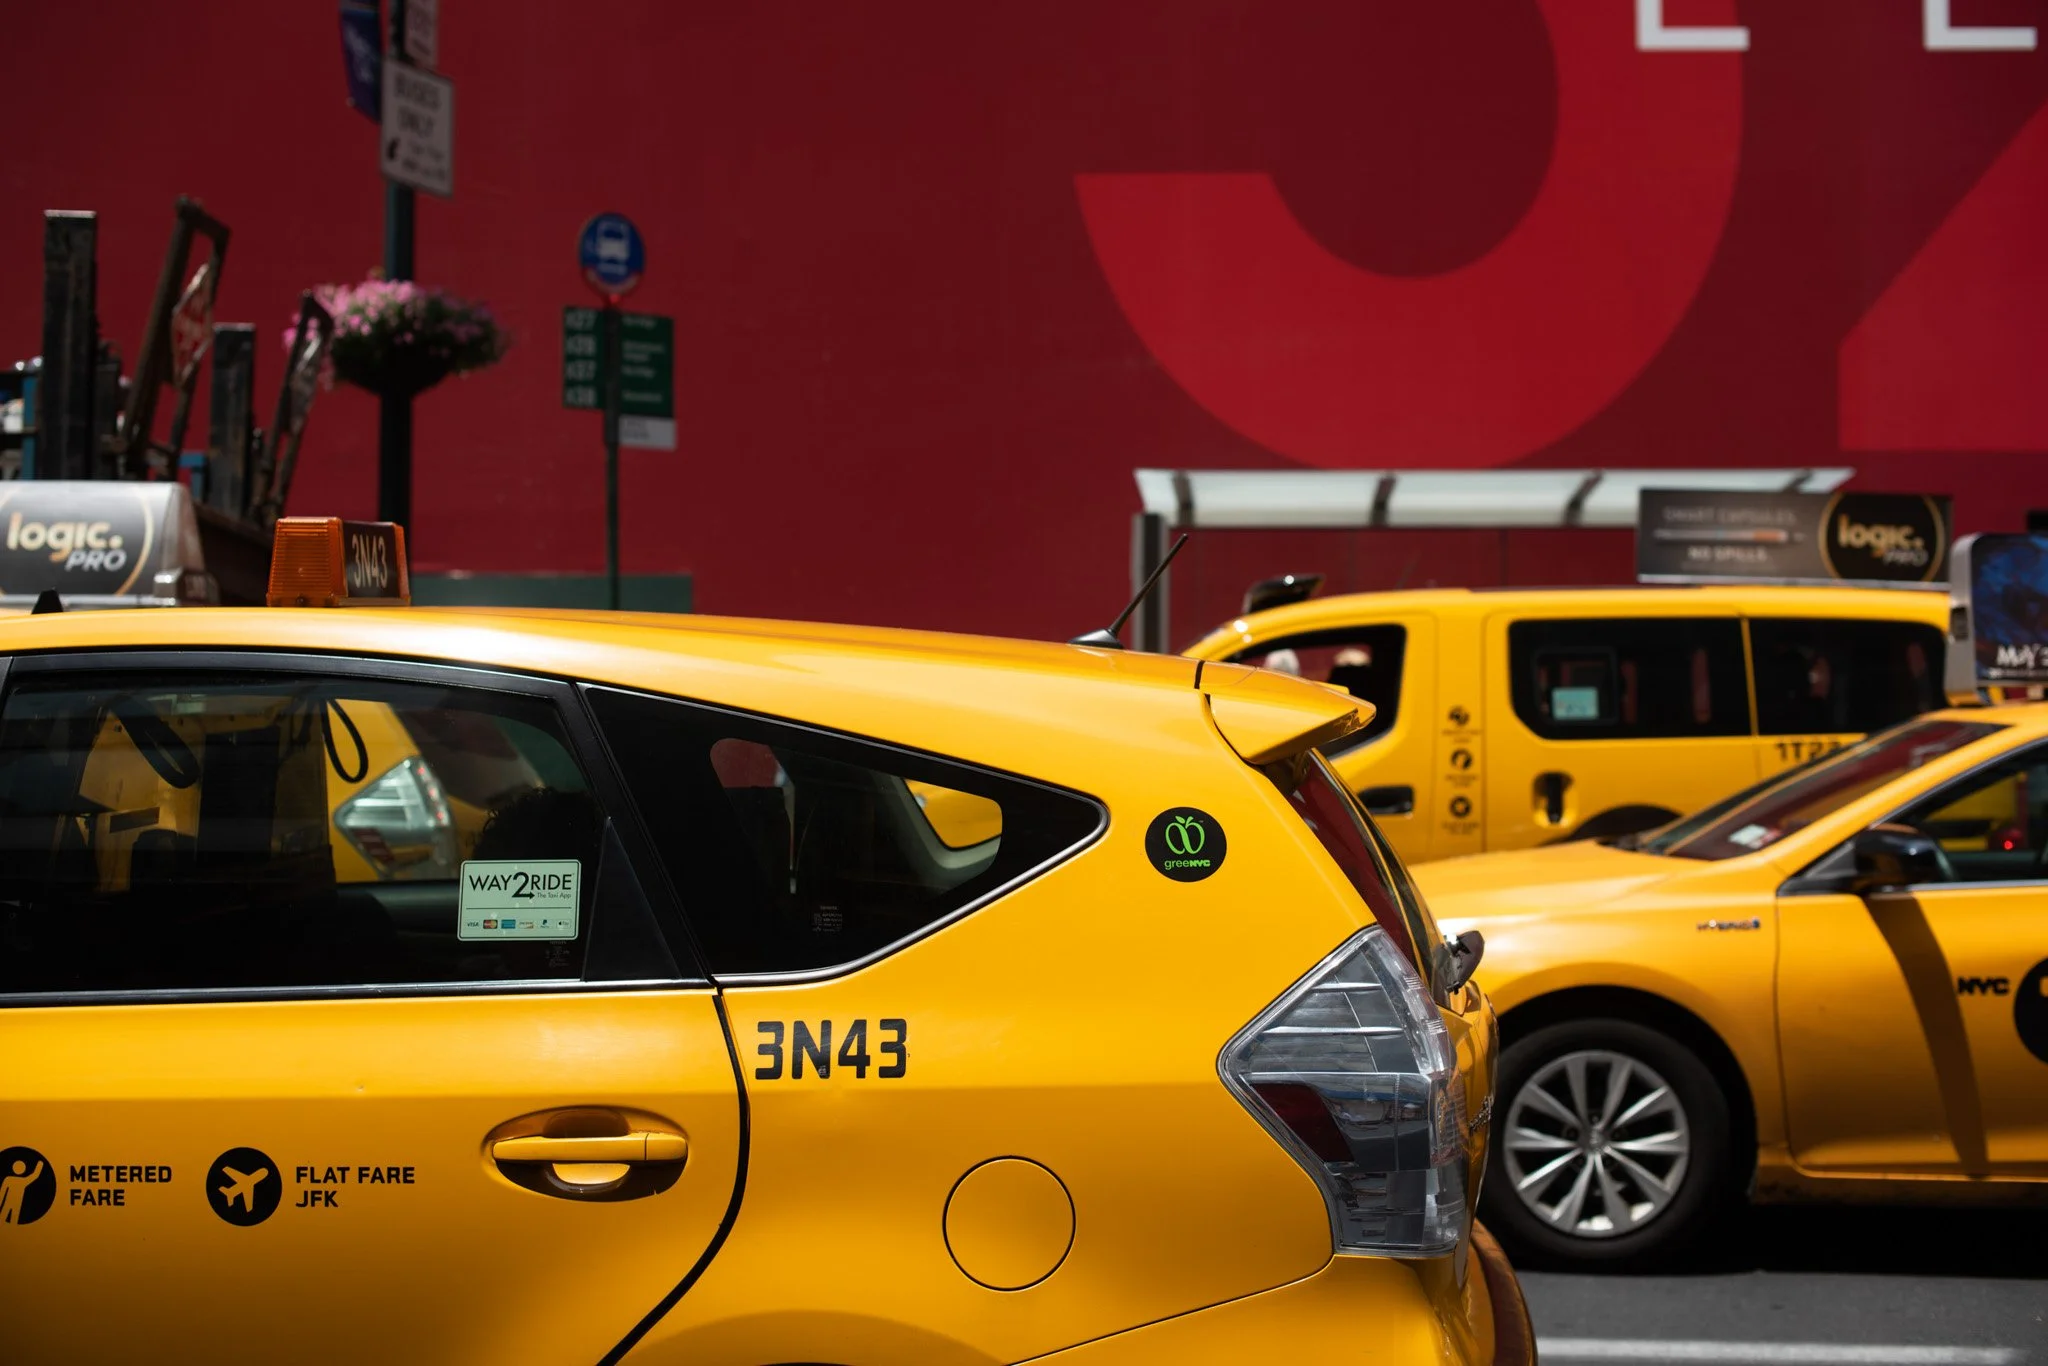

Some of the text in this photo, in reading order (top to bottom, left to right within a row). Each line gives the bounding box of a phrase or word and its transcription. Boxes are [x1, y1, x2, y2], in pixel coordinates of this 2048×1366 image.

[65, 551, 126, 572] PRO
[351, 534, 388, 588] 3N43
[1164, 859, 1211, 871] greeNYC
[469, 872, 573, 899] WAY2RIDE
[1958, 977, 2010, 995] NYC
[755, 1018, 907, 1079] 3N43
[70, 1165, 172, 1183] METERED
[296, 1166, 415, 1184] FLAT FARE
[70, 1189, 125, 1206] FARE
[296, 1190, 338, 1207] JFK
